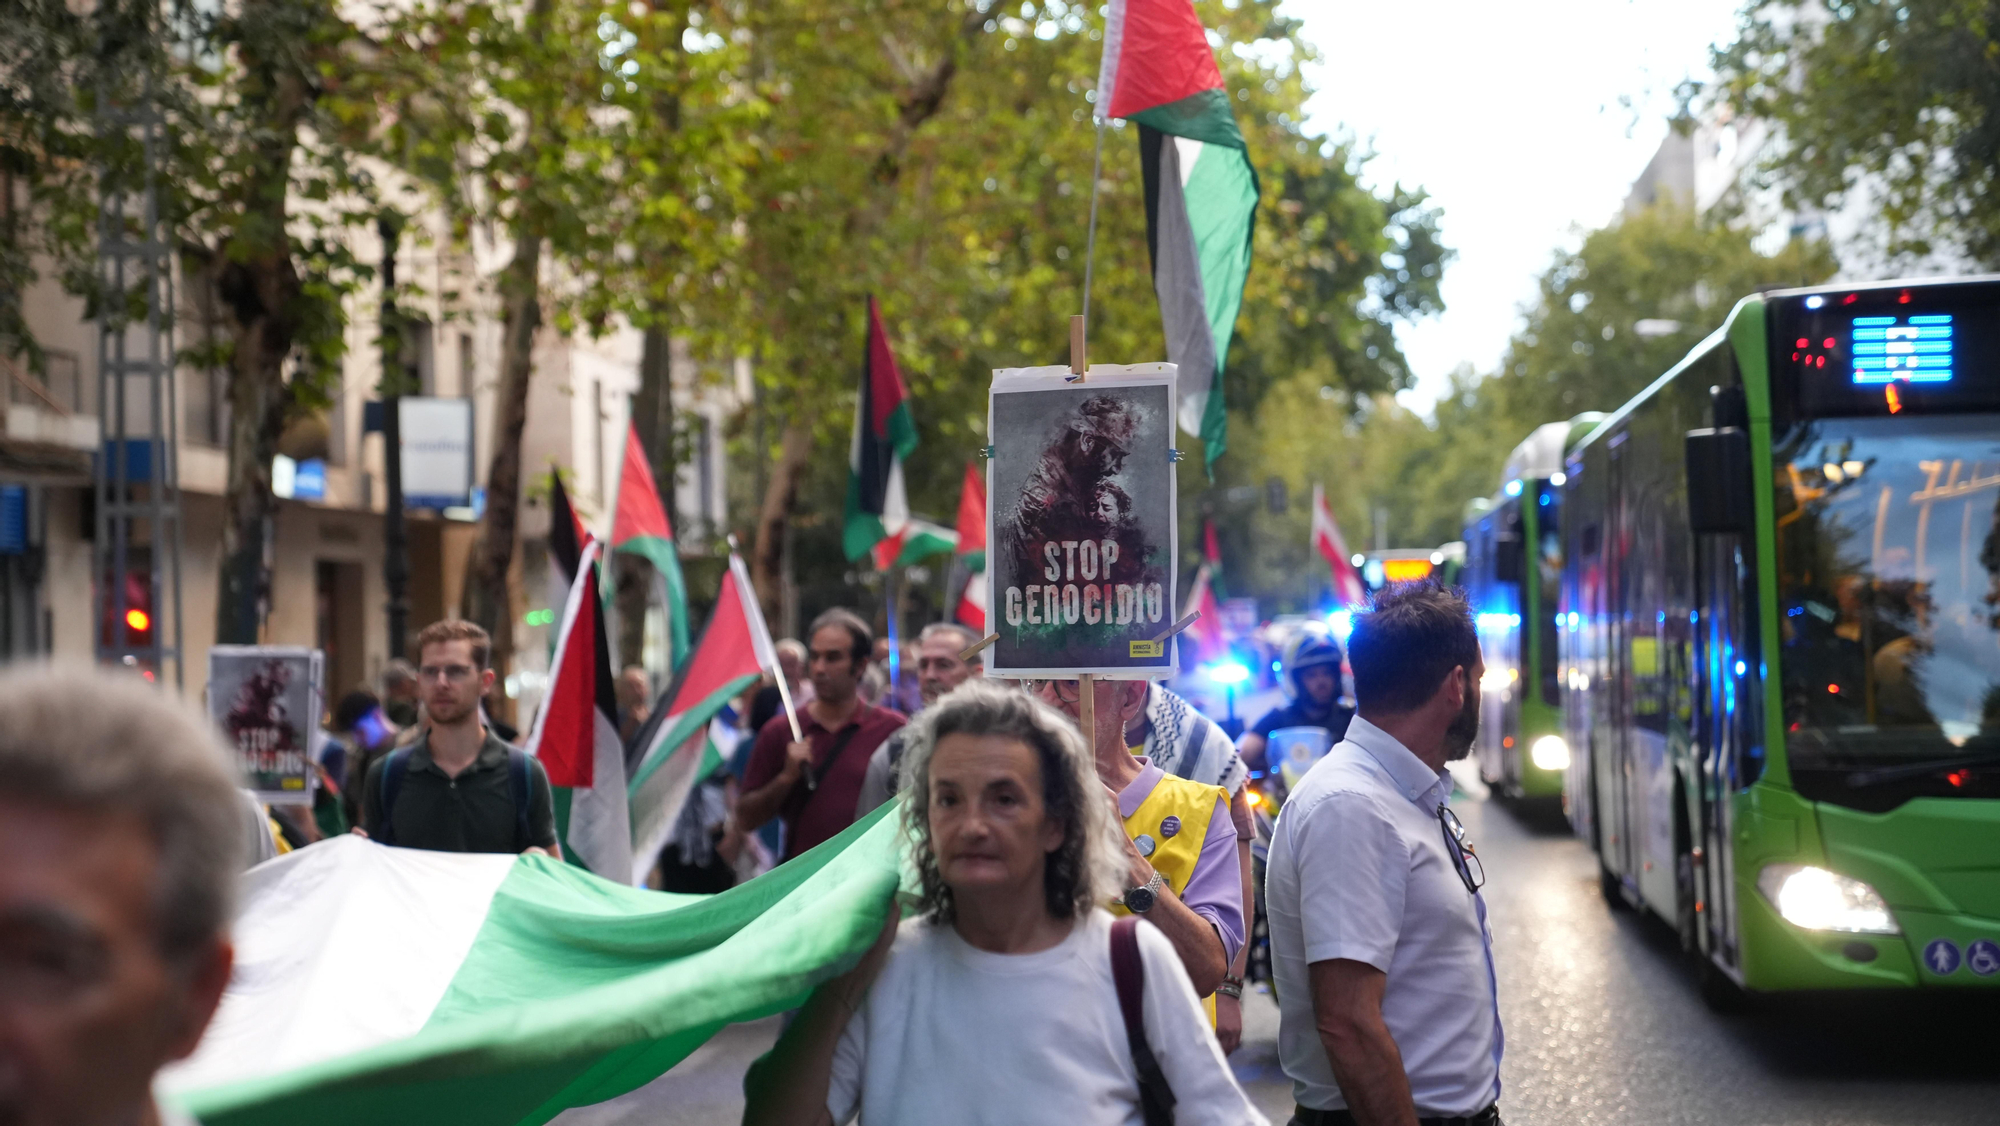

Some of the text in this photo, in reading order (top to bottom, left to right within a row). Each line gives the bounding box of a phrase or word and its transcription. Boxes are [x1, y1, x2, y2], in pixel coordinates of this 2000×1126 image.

[1044, 540, 1119, 582] STOP
[1005, 583, 1163, 626] GENOCIDIO
[239, 728, 280, 749] STOP
